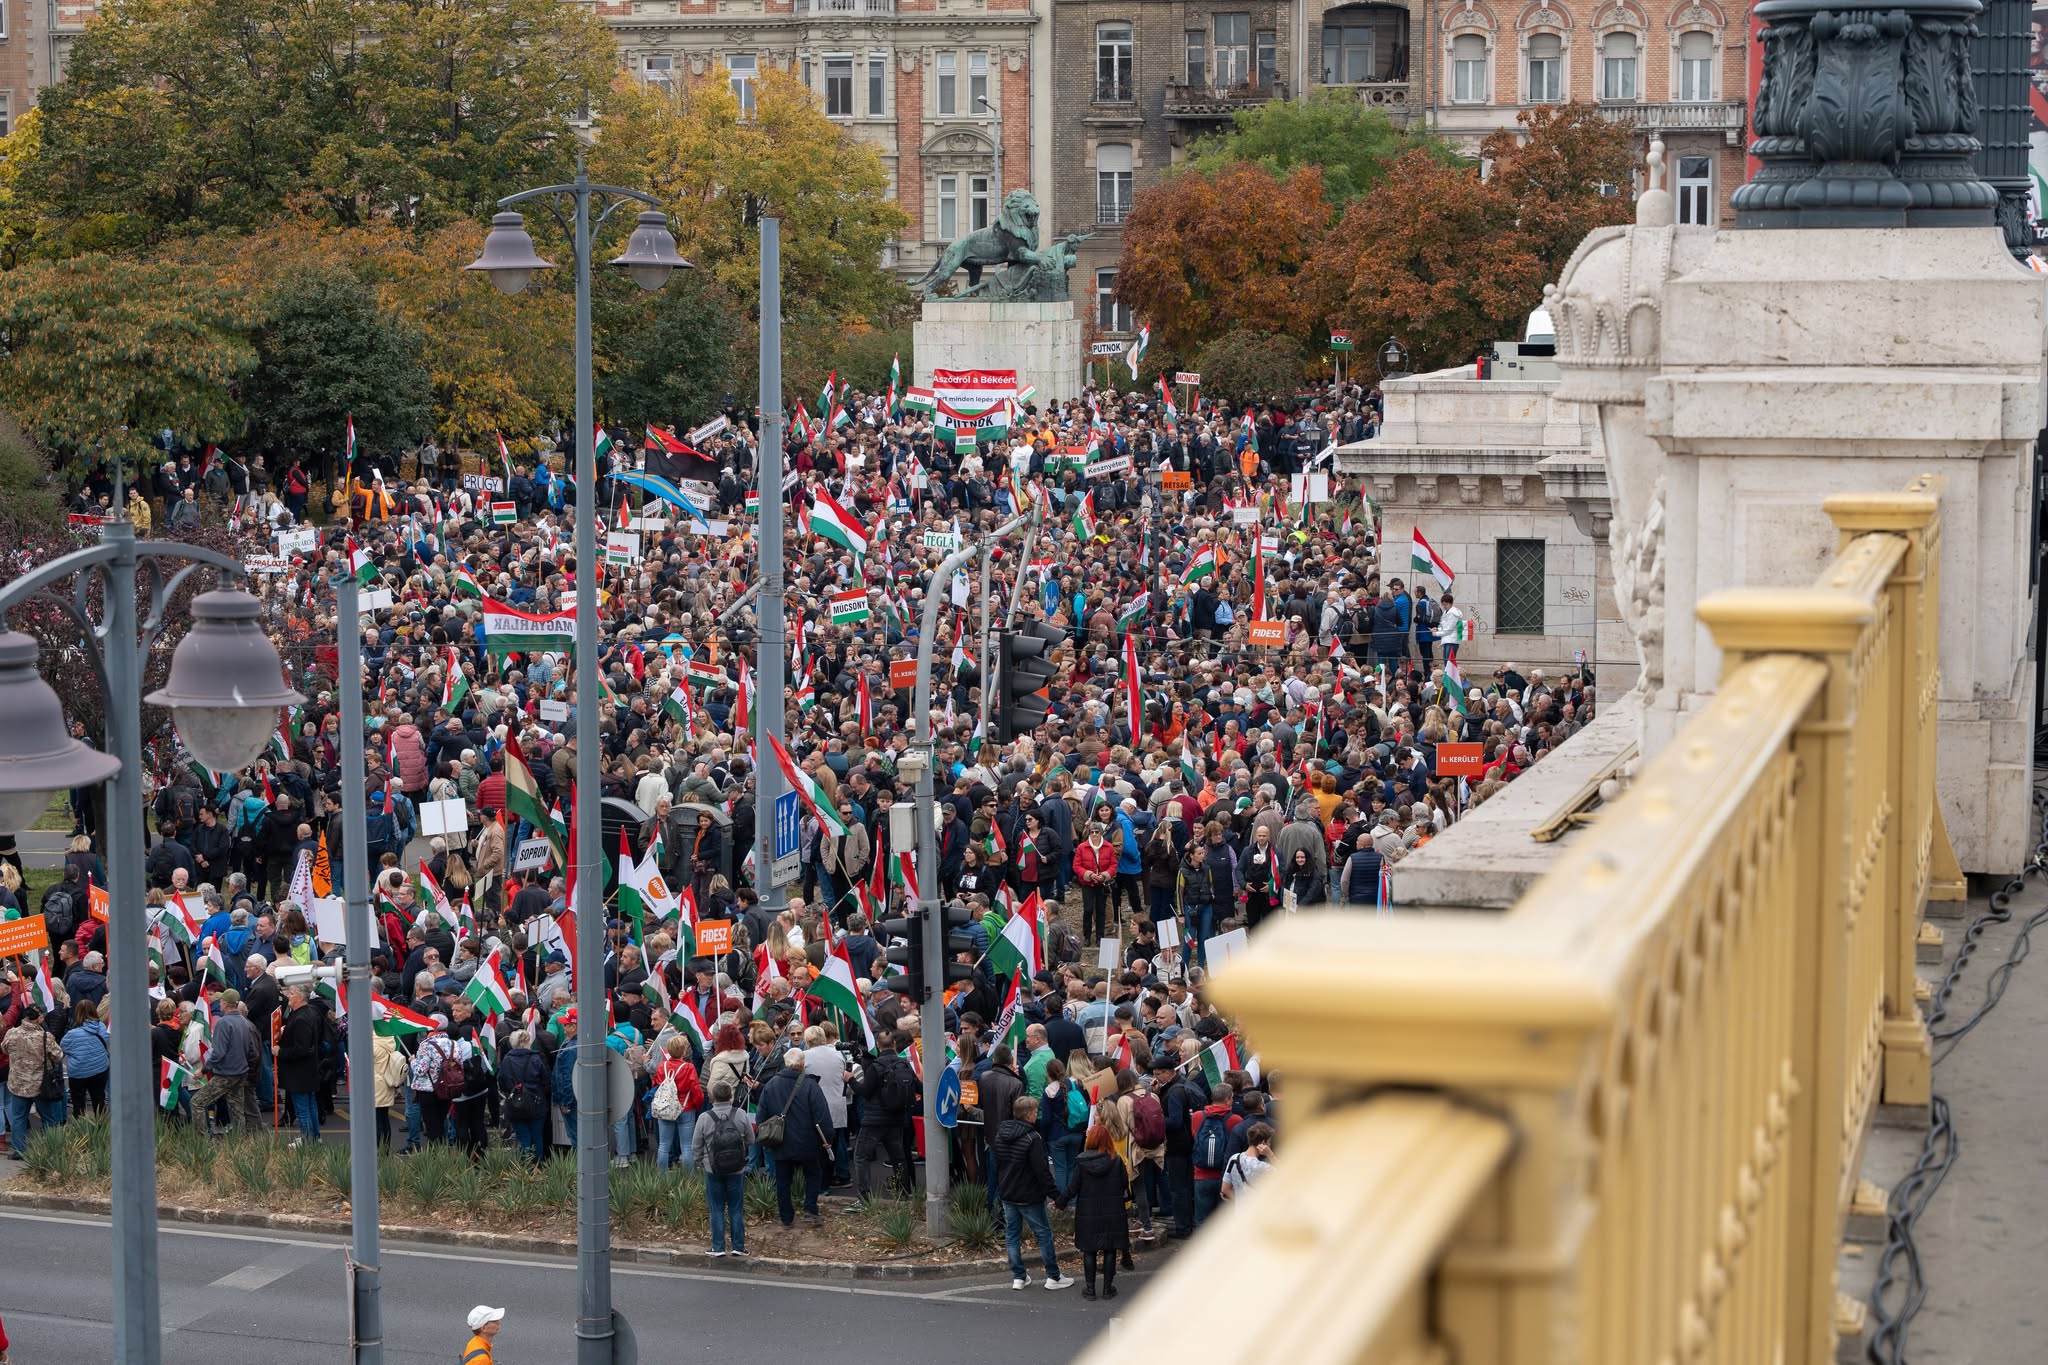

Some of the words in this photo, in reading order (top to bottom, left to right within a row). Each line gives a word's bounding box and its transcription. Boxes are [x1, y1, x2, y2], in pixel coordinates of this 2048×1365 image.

[1093, 343, 1121, 353] PUTNOK
[933, 375, 971, 384] Aszódról
[1176, 373, 1200, 383] MONOR
[975, 395, 993, 403] lépés
[945, 415, 994, 429] PUTNOK
[1088, 459, 1127, 474] Kesznyéten
[926, 533, 955, 548] TÉGLÁ
[833, 601, 867, 615] MÚCSONY
[1252, 628, 1282, 639] FIDESZ
[901, 669, 917, 677] KERÜ
[1450, 754, 1479, 763] KERÜLET
[519, 845, 548, 861] SOPRON
[94, 898, 110, 917] AJK
[701, 927, 728, 943] FIDESZ
